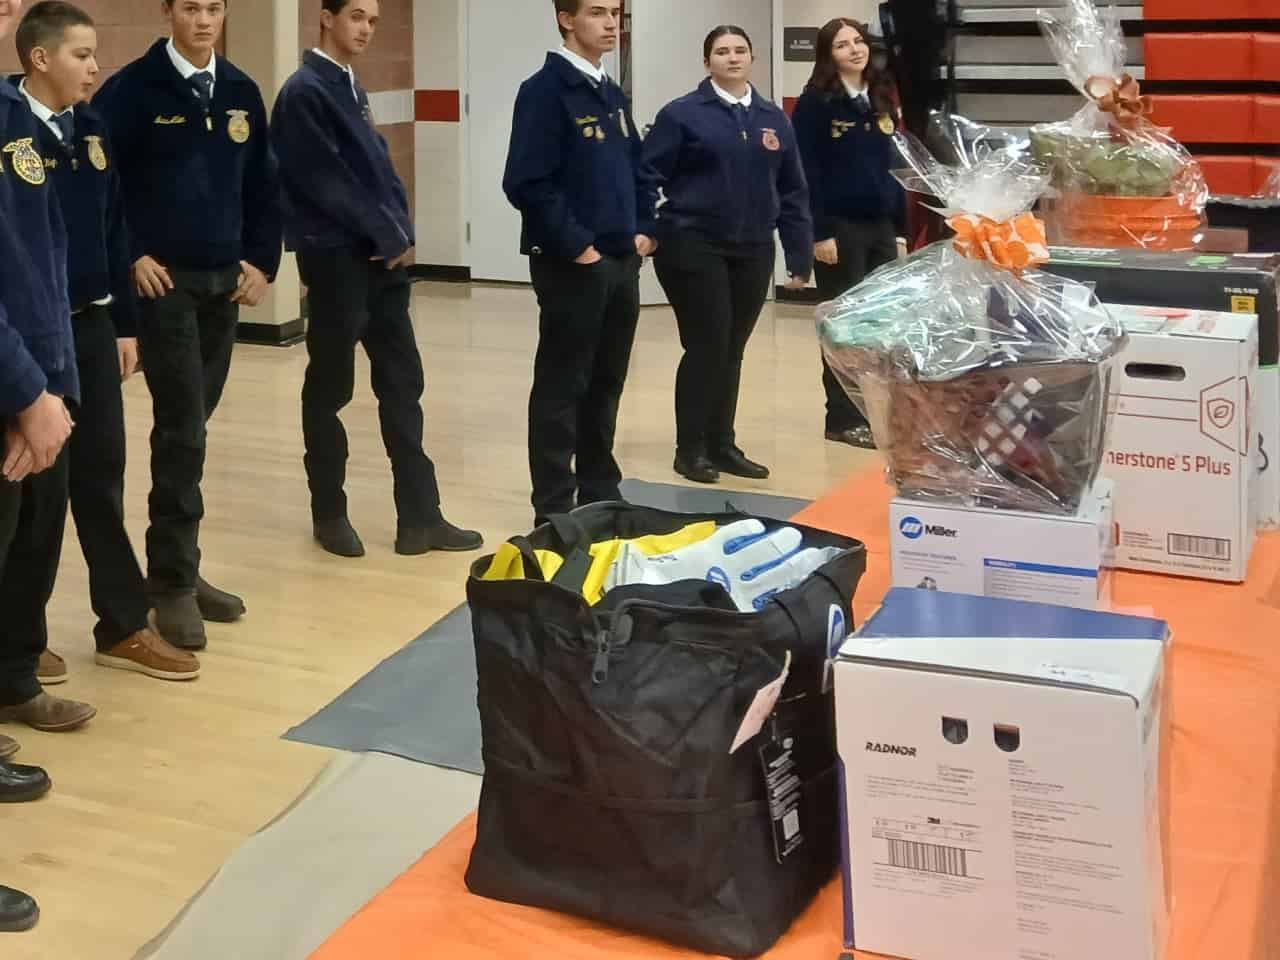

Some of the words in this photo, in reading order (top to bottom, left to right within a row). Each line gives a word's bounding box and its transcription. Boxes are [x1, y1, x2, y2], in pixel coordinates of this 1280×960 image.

[1195, 455, 1232, 476] Plus
[925, 524, 958, 538] Miller
[865, 741, 918, 758] RADNOR
